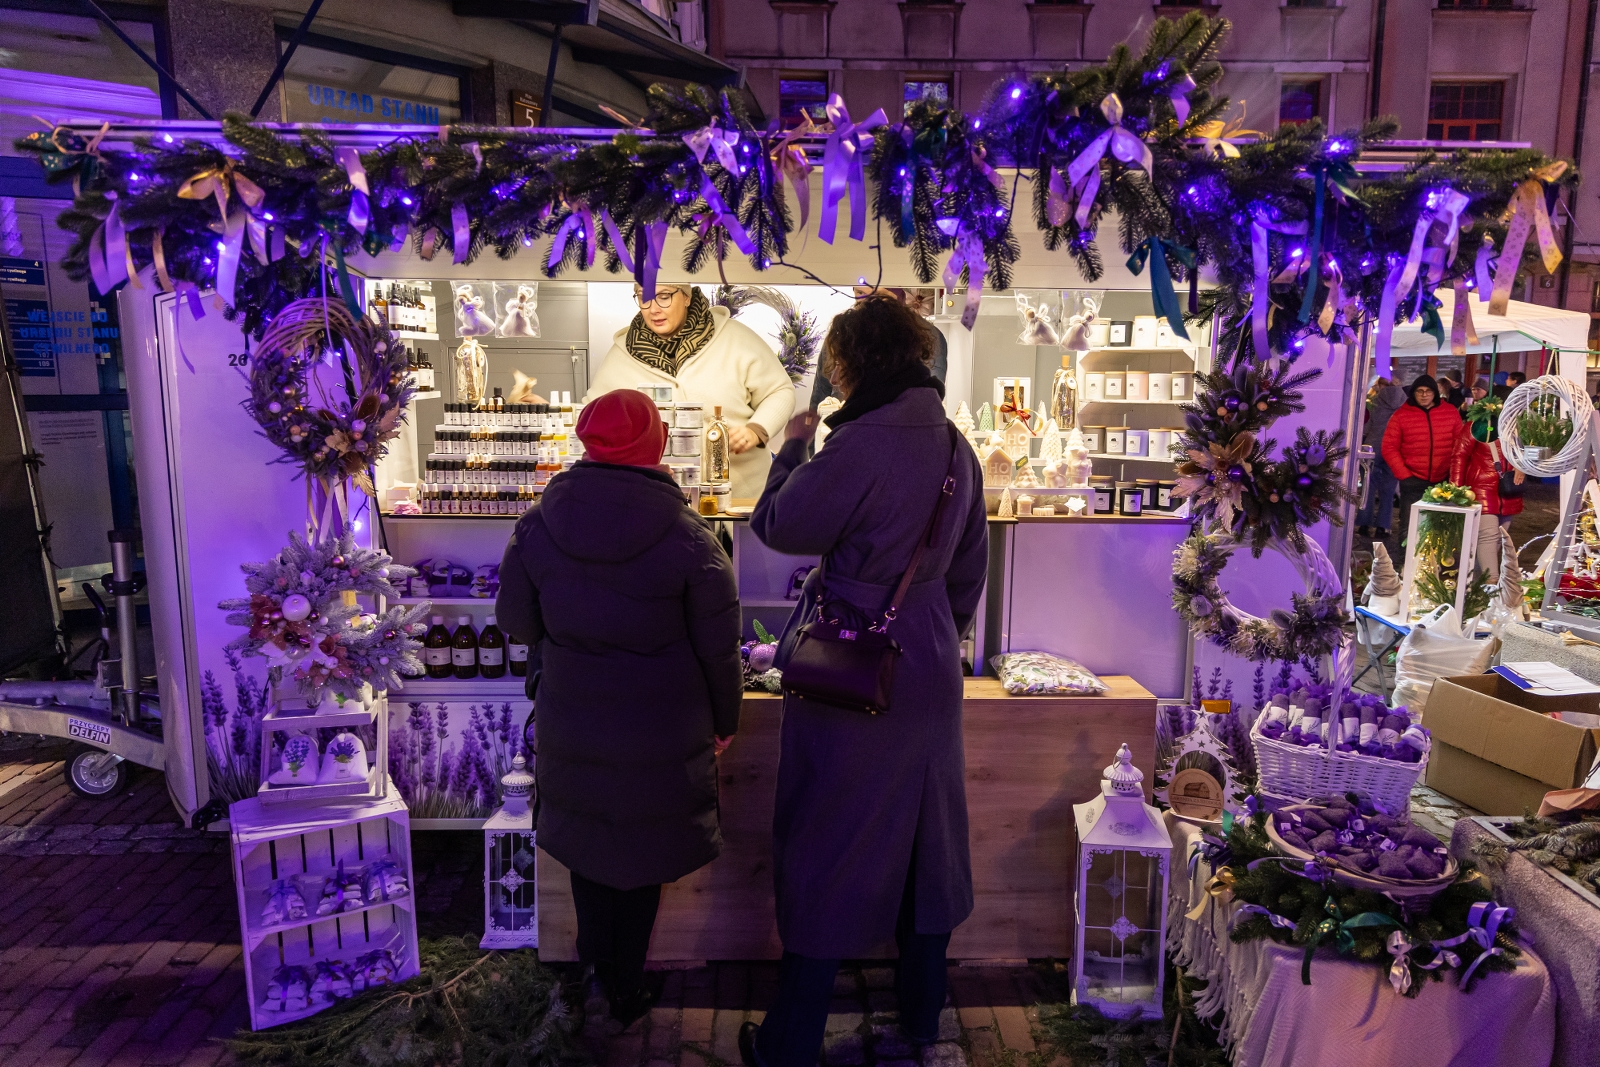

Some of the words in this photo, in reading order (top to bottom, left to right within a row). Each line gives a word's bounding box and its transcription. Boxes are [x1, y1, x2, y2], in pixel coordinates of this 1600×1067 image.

[307, 84, 375, 117] URZĄD
[381, 97, 439, 125] STANU
[525, 108, 535, 128] 5
[1545, 280, 1551, 288] 6
[90, 311, 108, 323] DO
[77, 327, 119, 339] STANU
[69, 718, 110, 732] PRZYCZEPY
[70, 725, 109, 743] DELFIN
